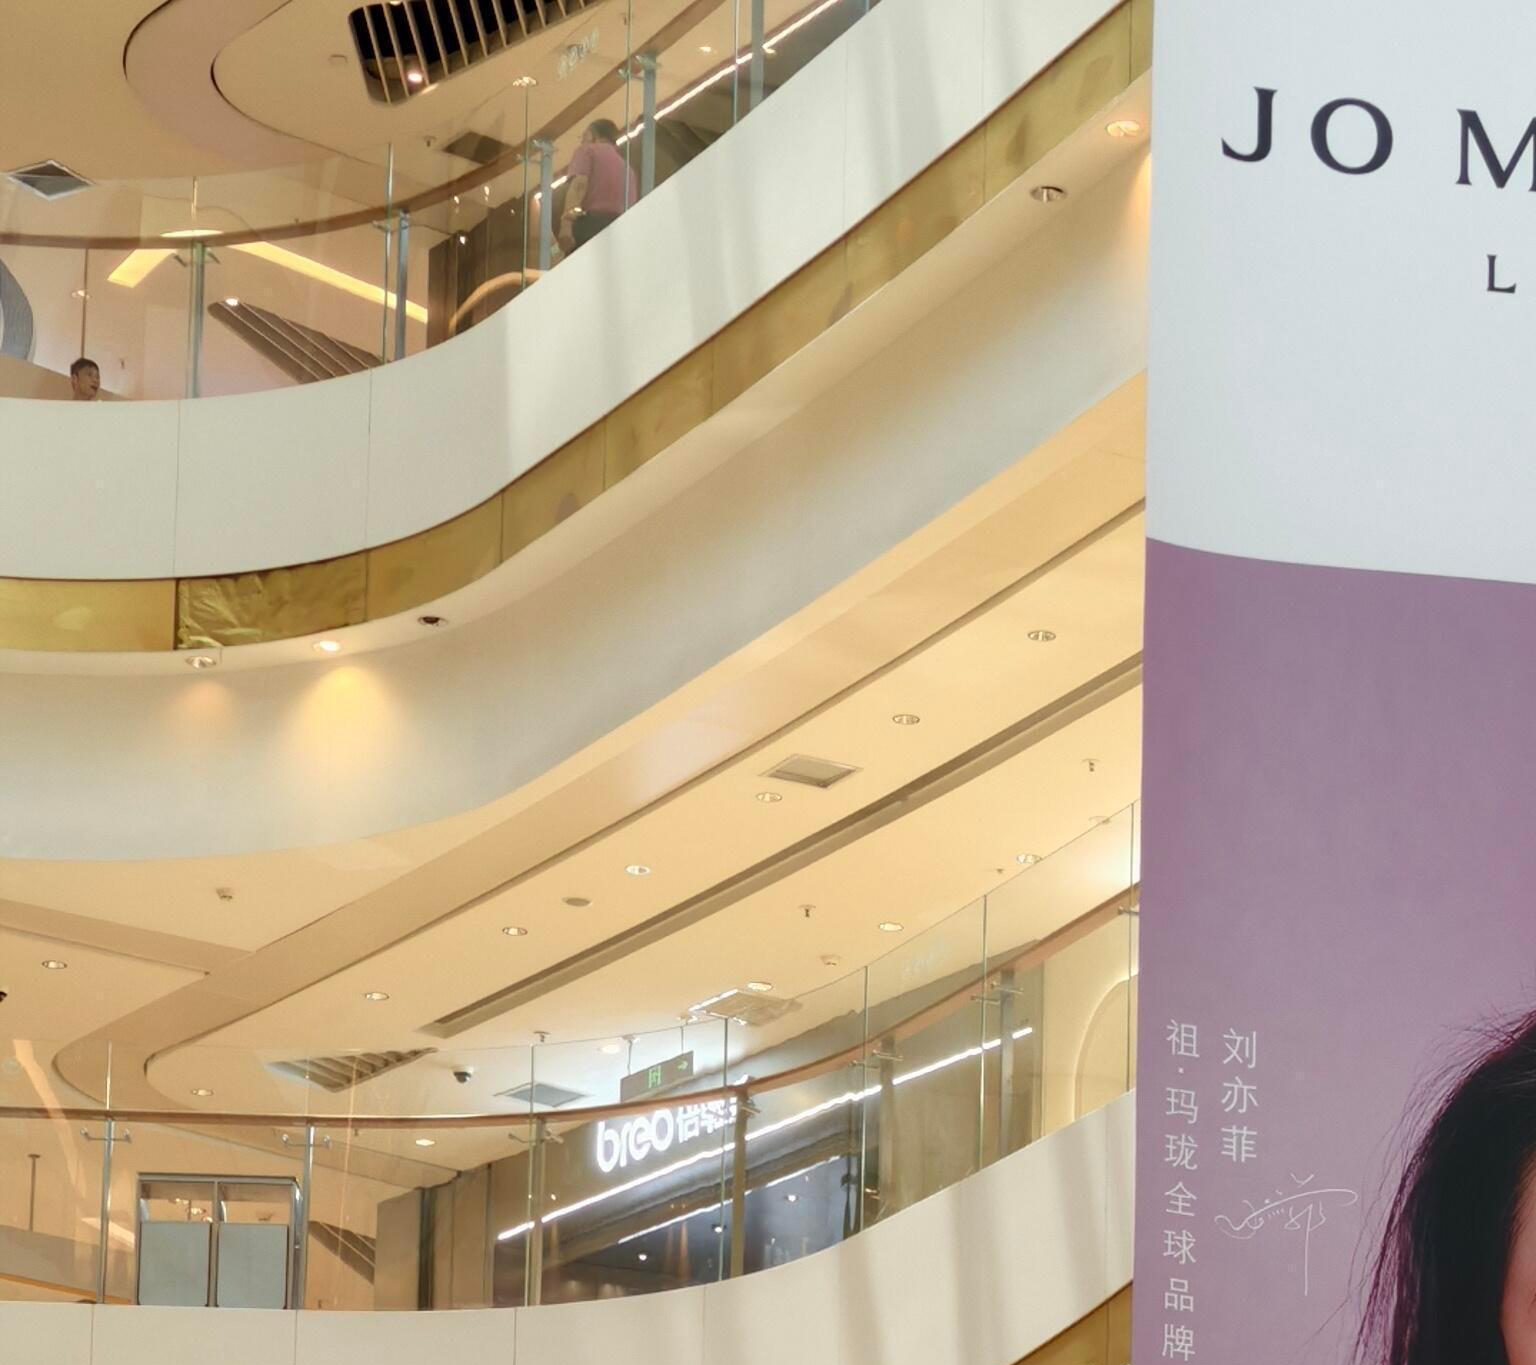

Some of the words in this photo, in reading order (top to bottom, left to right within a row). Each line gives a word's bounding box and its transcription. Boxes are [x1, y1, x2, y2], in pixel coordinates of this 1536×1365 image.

[1221, 86, 1394, 175] JO
[1221, 1028, 1259, 1163] 刘亦菲
[596, 1108, 674, 1173] breo
